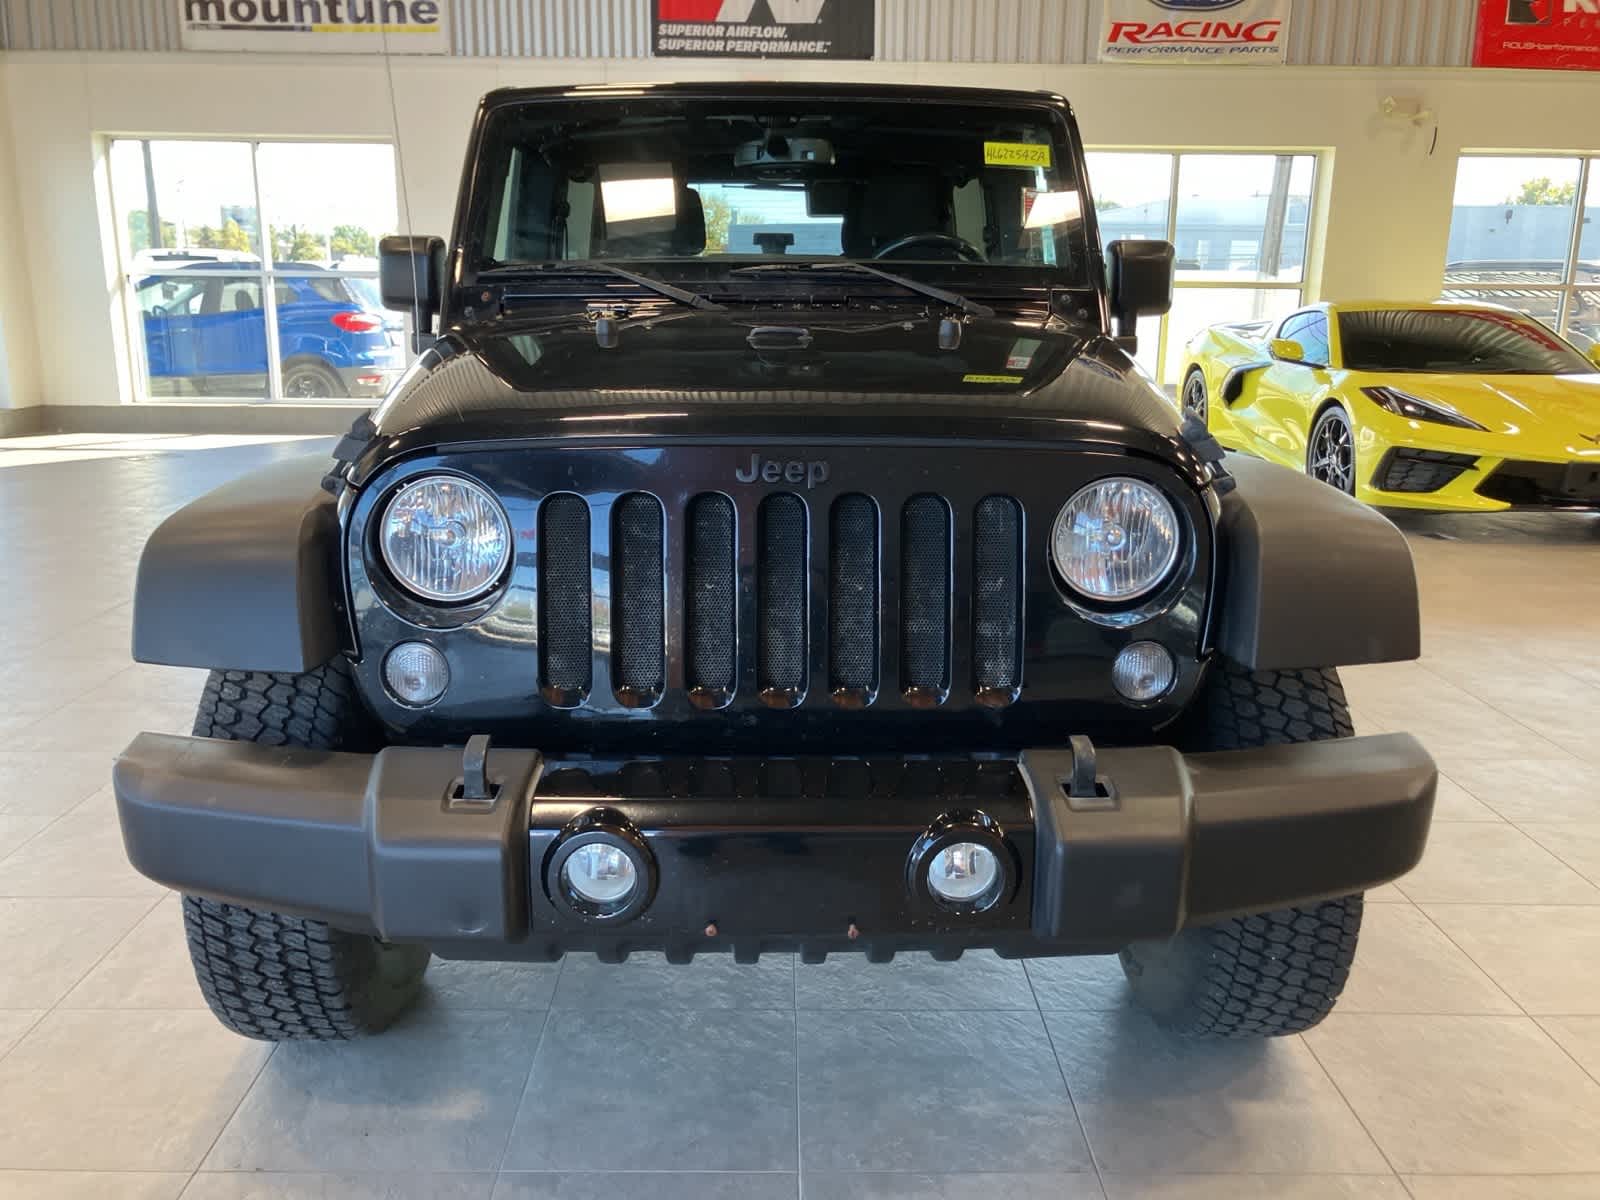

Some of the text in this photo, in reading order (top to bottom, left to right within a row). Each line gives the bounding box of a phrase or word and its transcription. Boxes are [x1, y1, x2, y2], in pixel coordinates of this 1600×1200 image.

[186, 0, 439, 24] mountune
[658, 24, 788, 38] SUPERIOR AIRFLOW.
[1107, 21, 1281, 44] RACING
[658, 38, 725, 51] SUPERIOR
[1106, 46, 1279, 54] PERFORMANCE PARTS
[735, 453, 831, 489] Jeep
